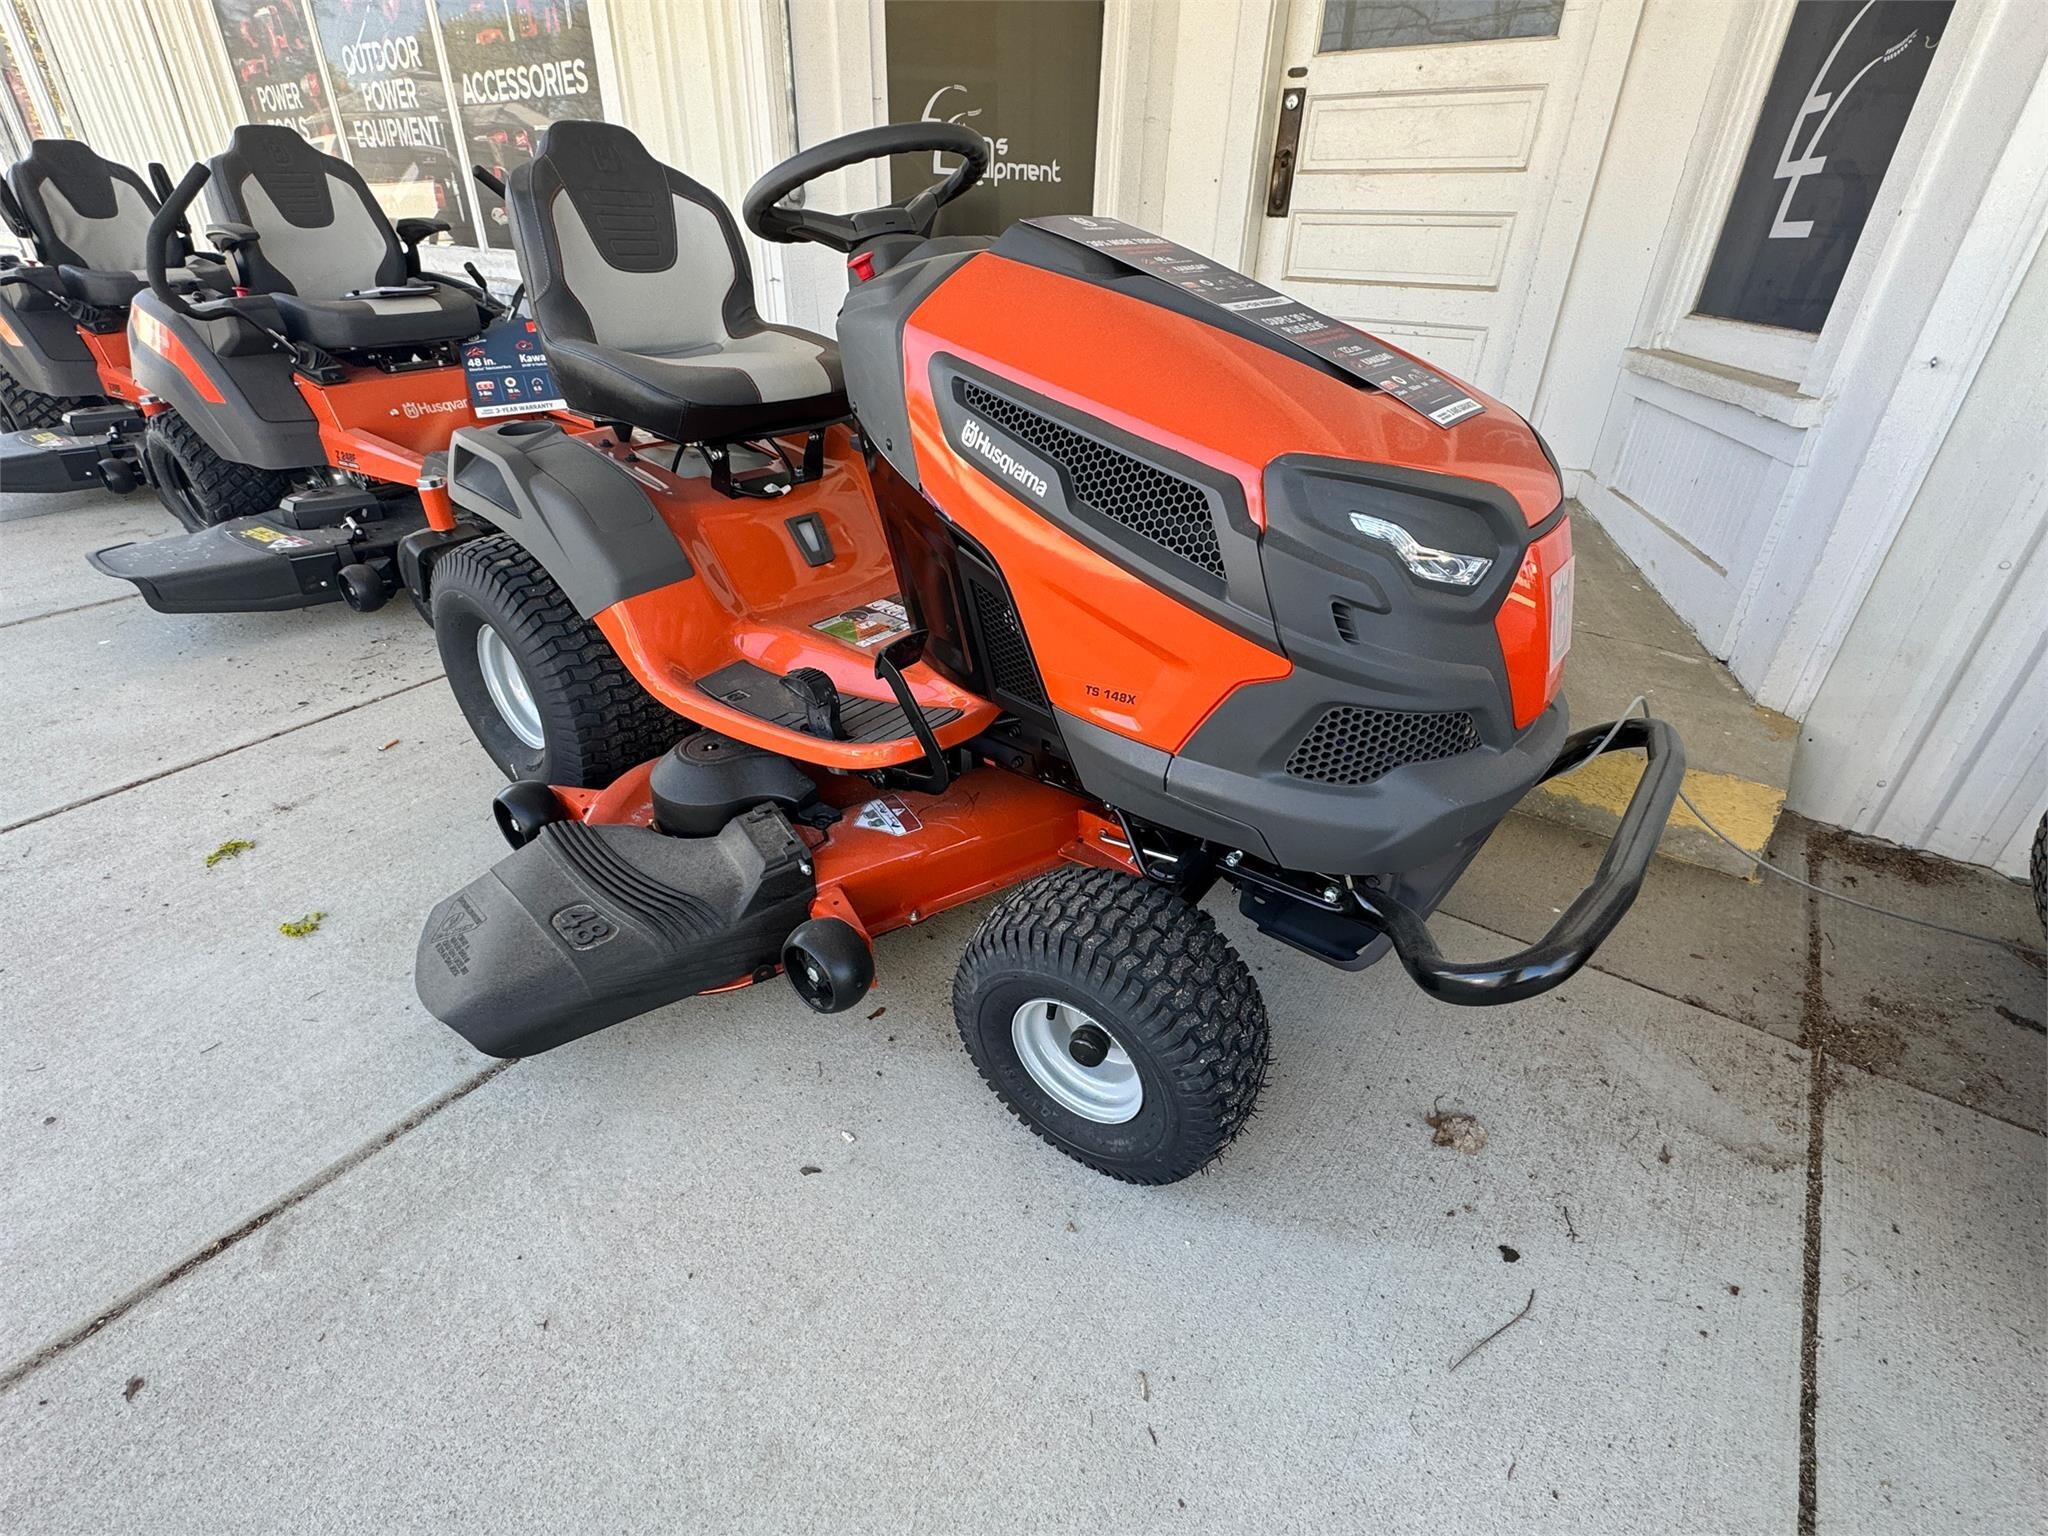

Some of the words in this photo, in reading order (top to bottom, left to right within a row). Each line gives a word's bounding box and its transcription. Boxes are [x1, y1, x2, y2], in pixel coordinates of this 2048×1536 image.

[342, 36, 423, 76] OUTDOOR
[256, 82, 304, 112] POWER
[361, 78, 420, 111] POWER
[462, 58, 589, 105] ACCESSORIES
[353, 116, 441, 148] EQUIPMENT
[467, 358, 481, 368] 48
[518, 402, 553, 411] WARRANTY
[975, 431, 1048, 498] Husqvarna
[1085, 685, 1100, 697] TS
[1103, 690, 1137, 705] 148X
[561, 909, 610, 946] 48
